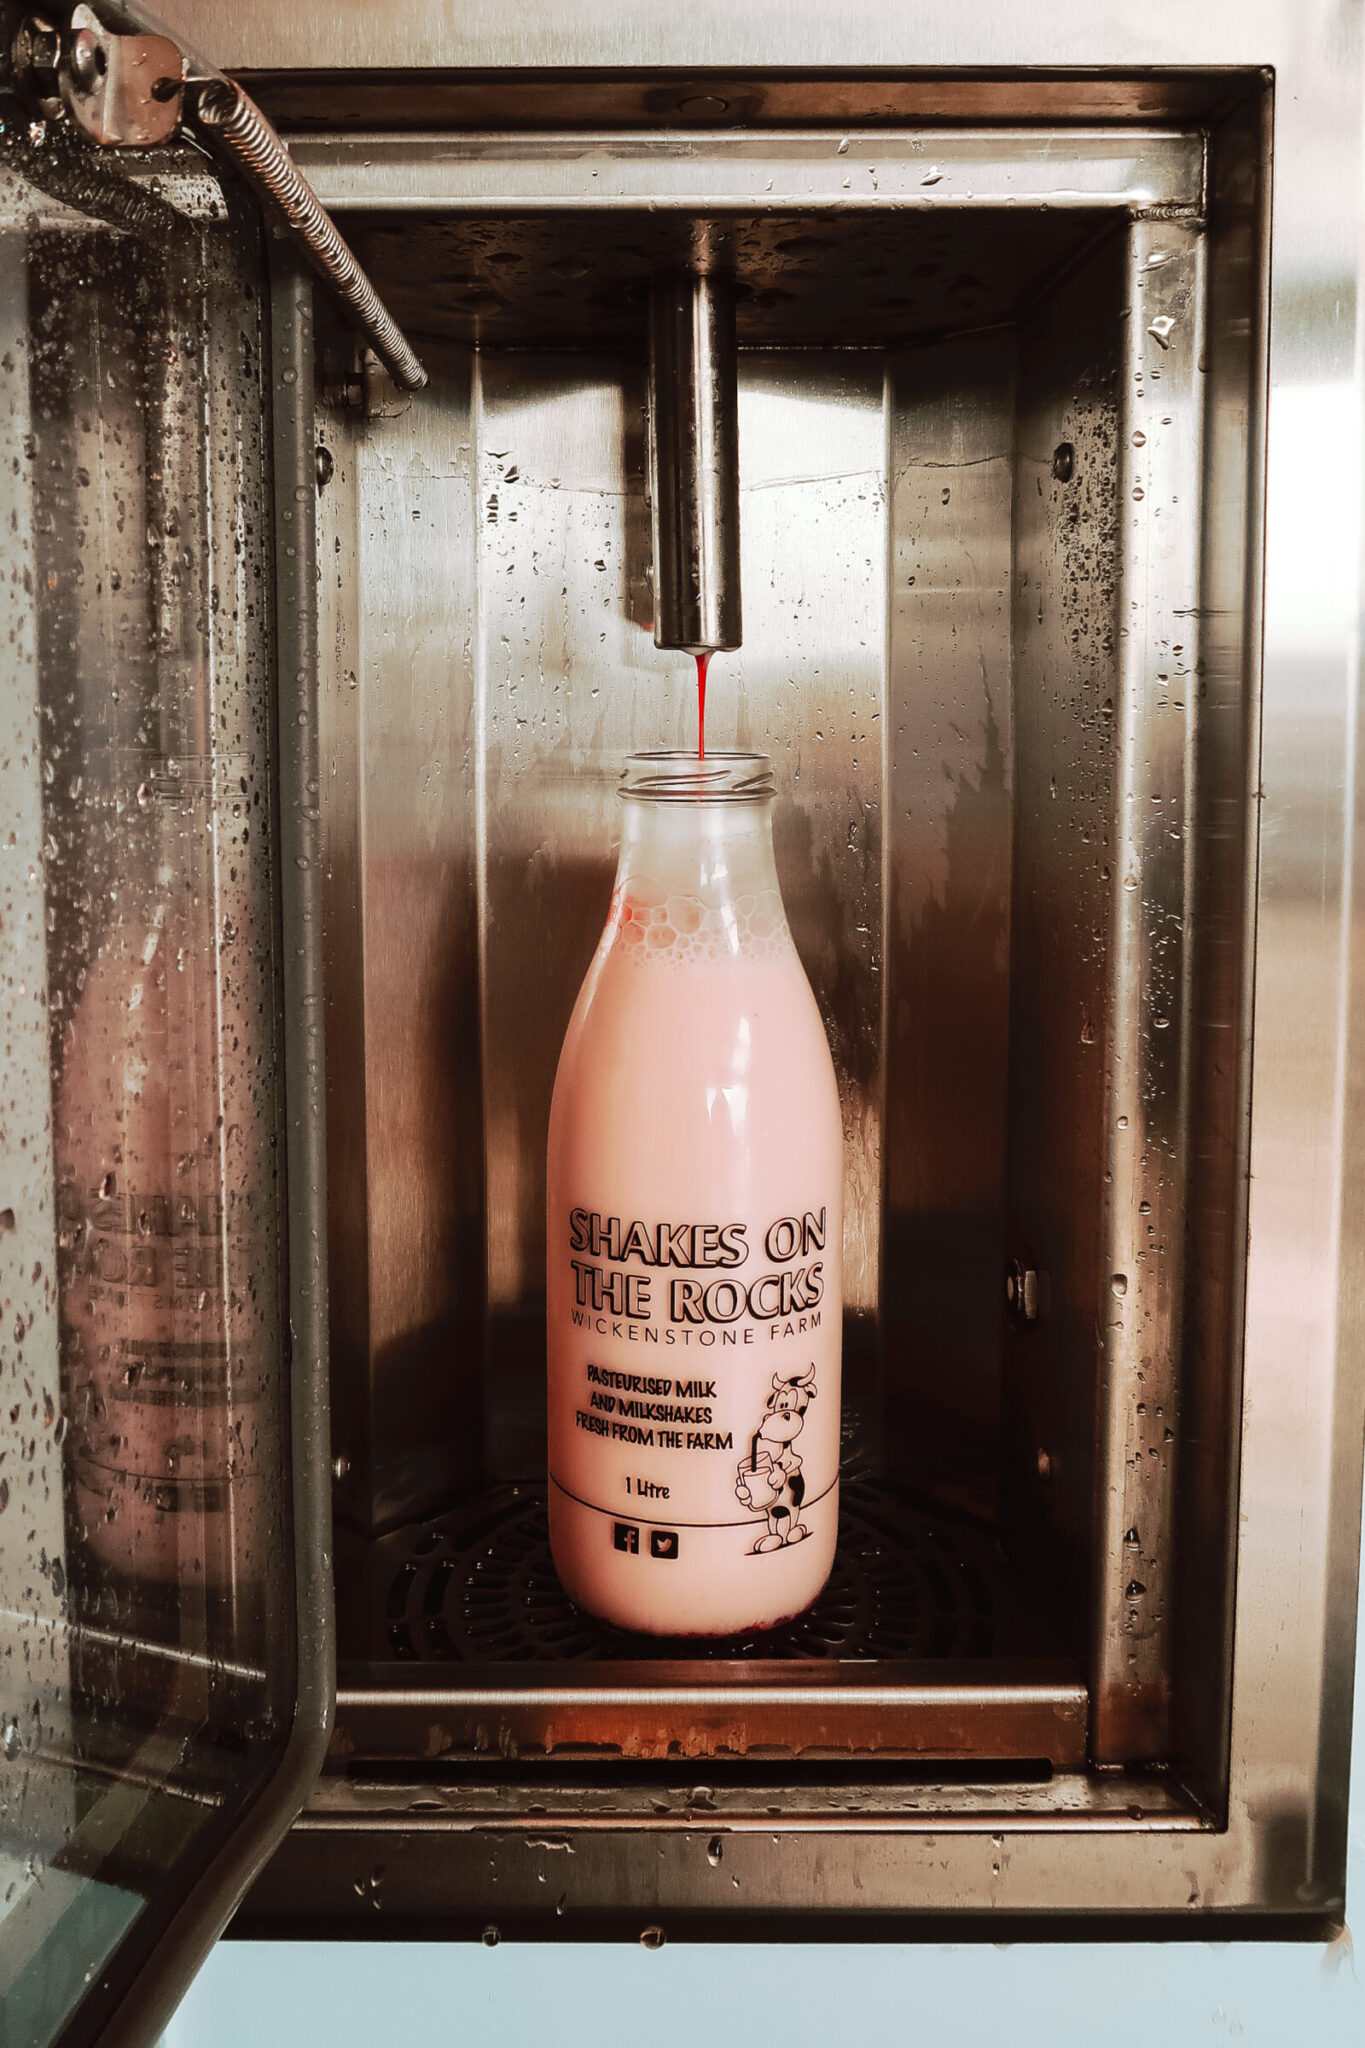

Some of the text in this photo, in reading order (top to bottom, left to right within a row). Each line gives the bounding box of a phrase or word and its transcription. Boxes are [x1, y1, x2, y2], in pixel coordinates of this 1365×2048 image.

[570, 1206, 826, 1268] SHAKES ON
[570, 1259, 824, 1324] THE ROCKS
[571, 1308, 822, 1346] WICKENSTONE FARM
[587, 1364, 717, 1398] PASTEURISED MILK
[590, 1391, 713, 1424] AND MILKSHAKES
[575, 1410, 733, 1450] FRESH FROM THE FARM
[626, 1476, 670, 1499] 1 Litre
